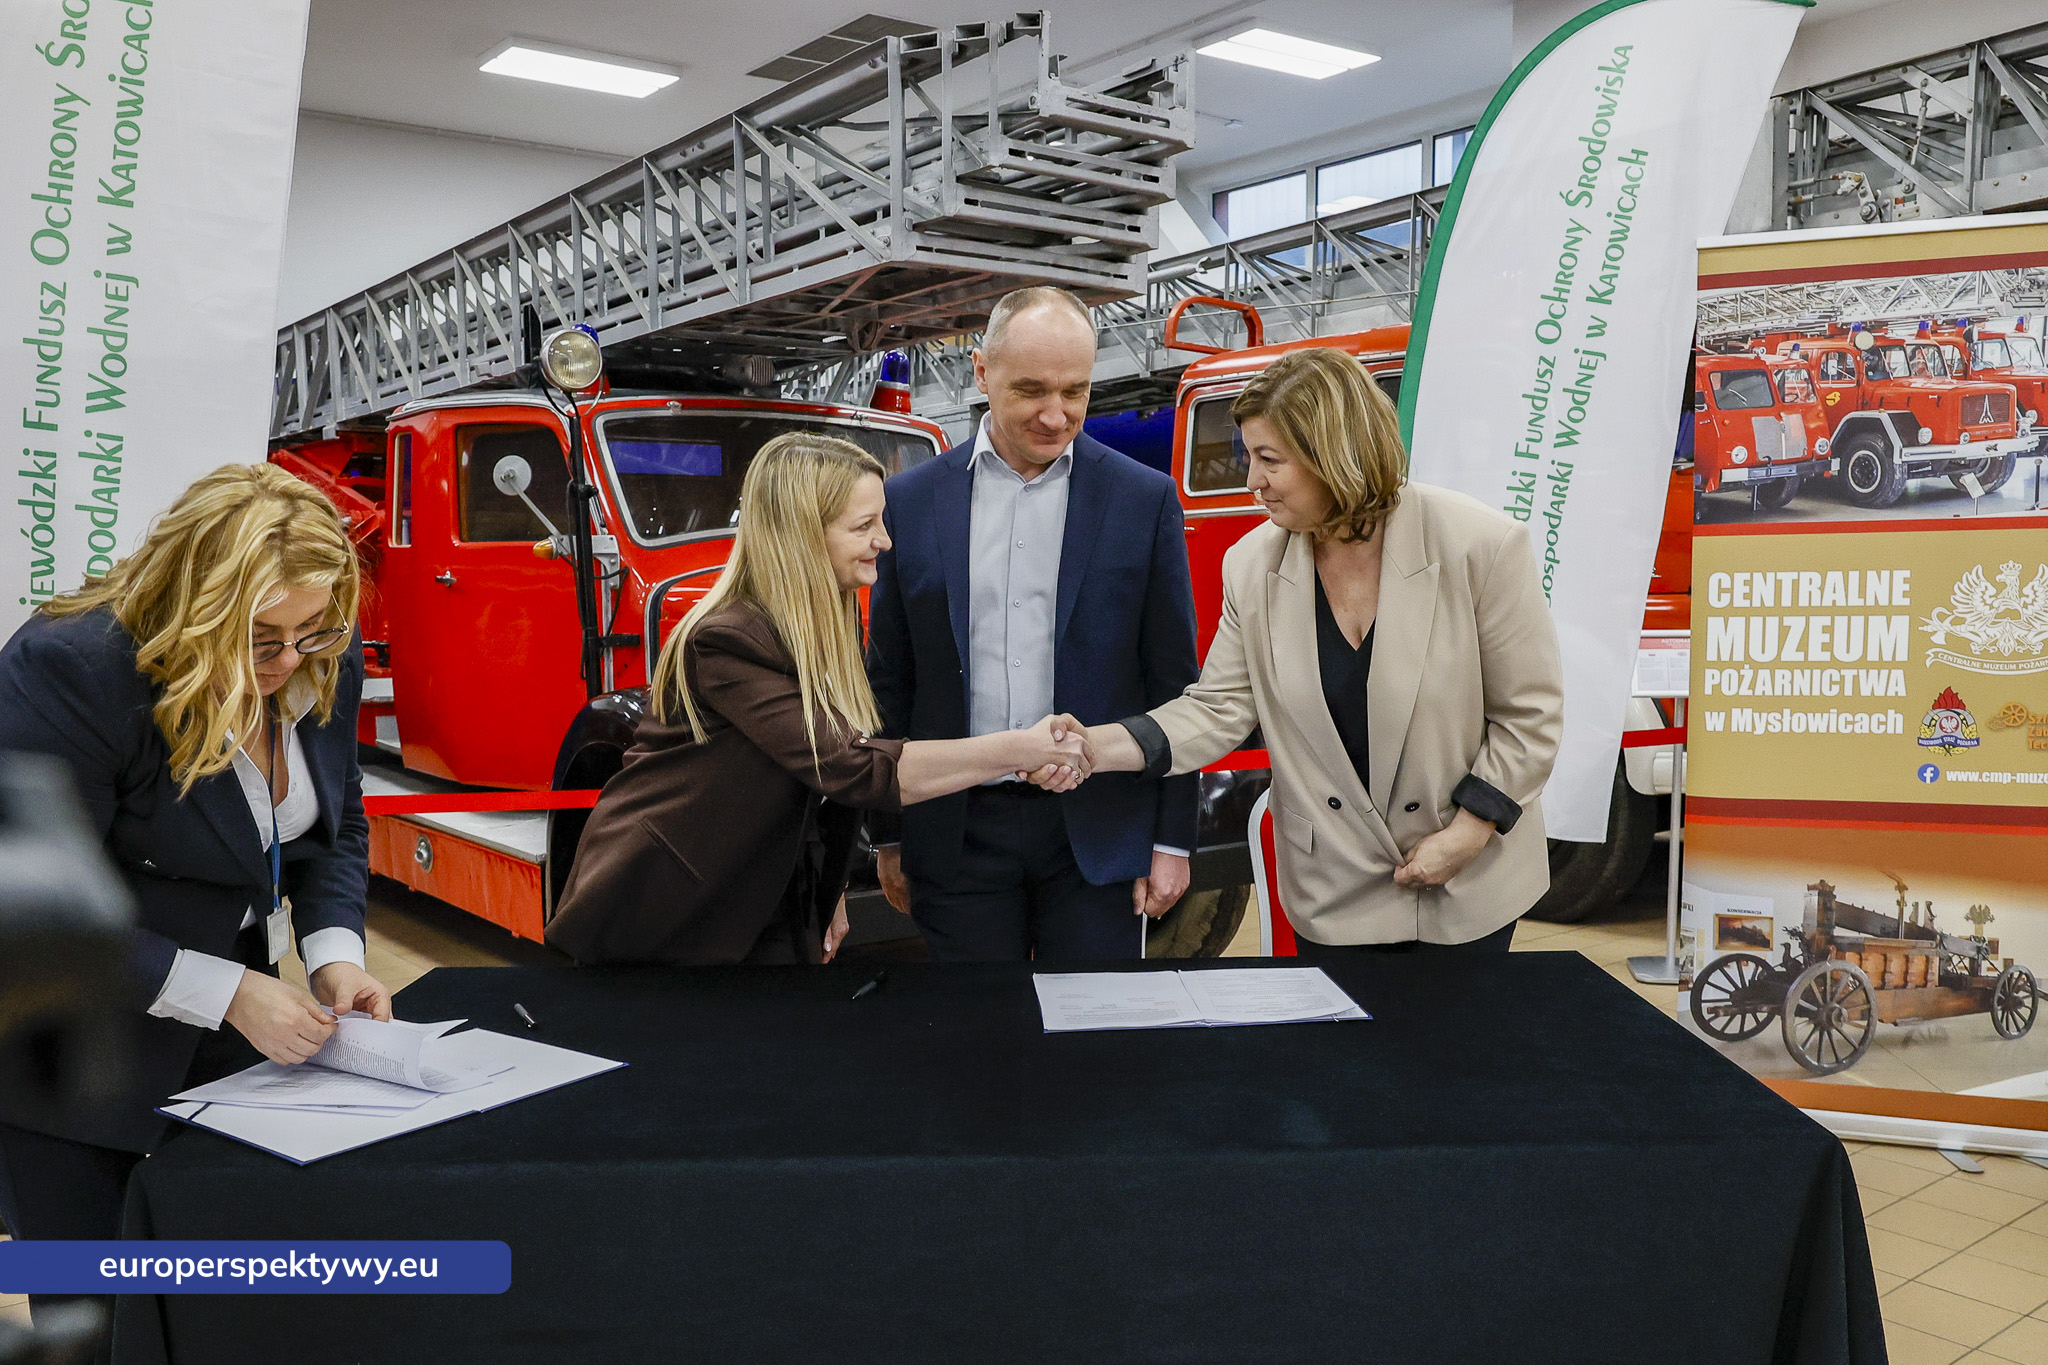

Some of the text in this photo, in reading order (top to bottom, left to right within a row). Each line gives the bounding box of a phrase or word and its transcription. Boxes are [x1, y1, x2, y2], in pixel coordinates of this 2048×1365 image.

[106, 223, 132, 256] w
[1585, 315, 1608, 338] w
[1708, 569, 1911, 608] CENTRALNE
[1706, 615, 1910, 662] MUZEUM
[1938, 652, 1981, 668] CENTRALNE
[1983, 662, 2016, 670] MUZEUM
[1704, 664, 1907, 697] POŻARNICTWA
[1704, 708, 1904, 735] w Mysłowicach
